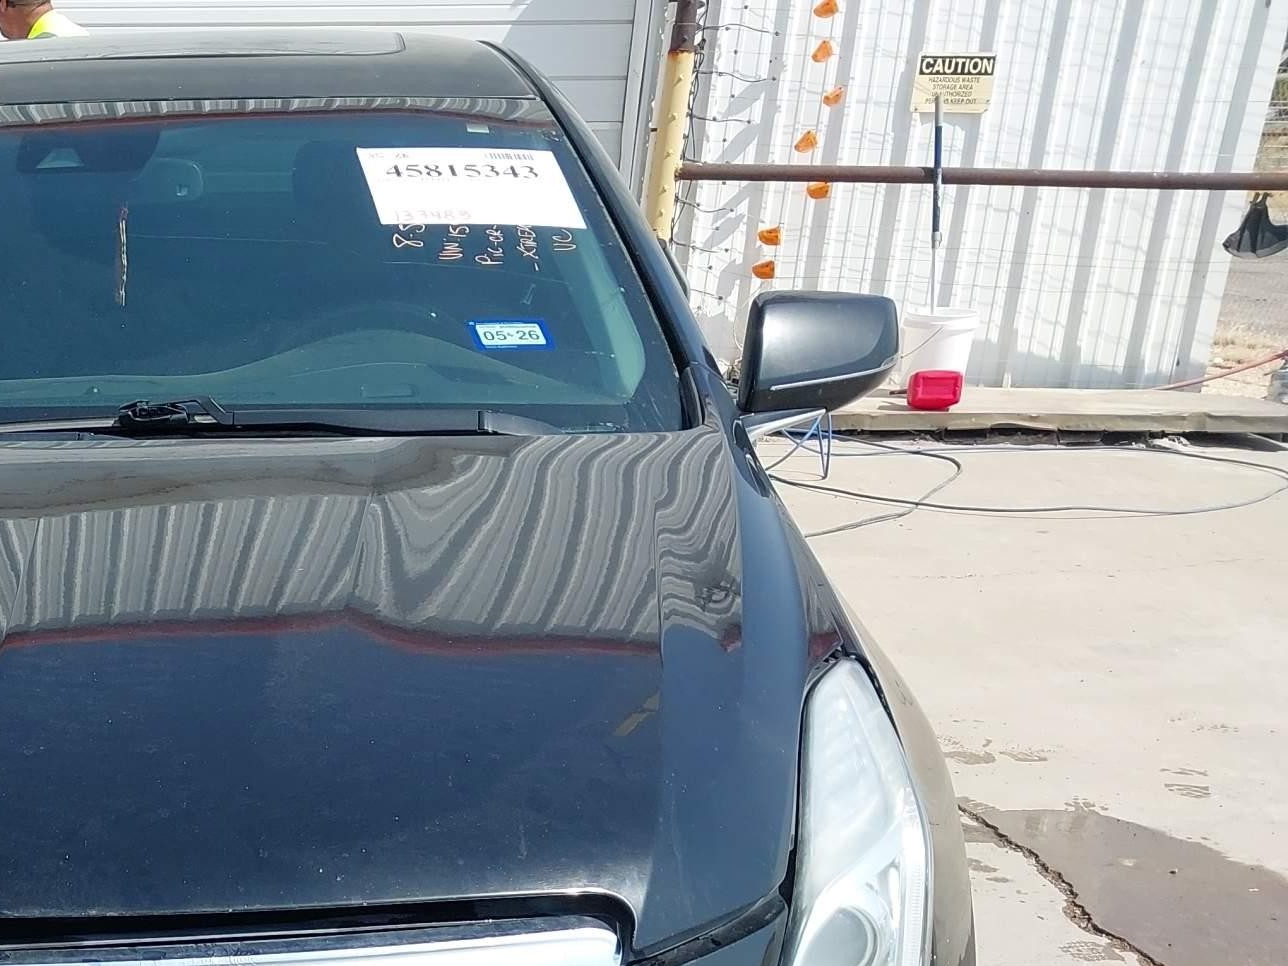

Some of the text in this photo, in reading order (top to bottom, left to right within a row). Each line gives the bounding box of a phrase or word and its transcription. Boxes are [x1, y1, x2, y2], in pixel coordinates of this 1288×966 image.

[922, 57, 994, 74] CAUTION
[385, 163, 540, 179] 45815343
[483, 329, 540, 341] 05 26
